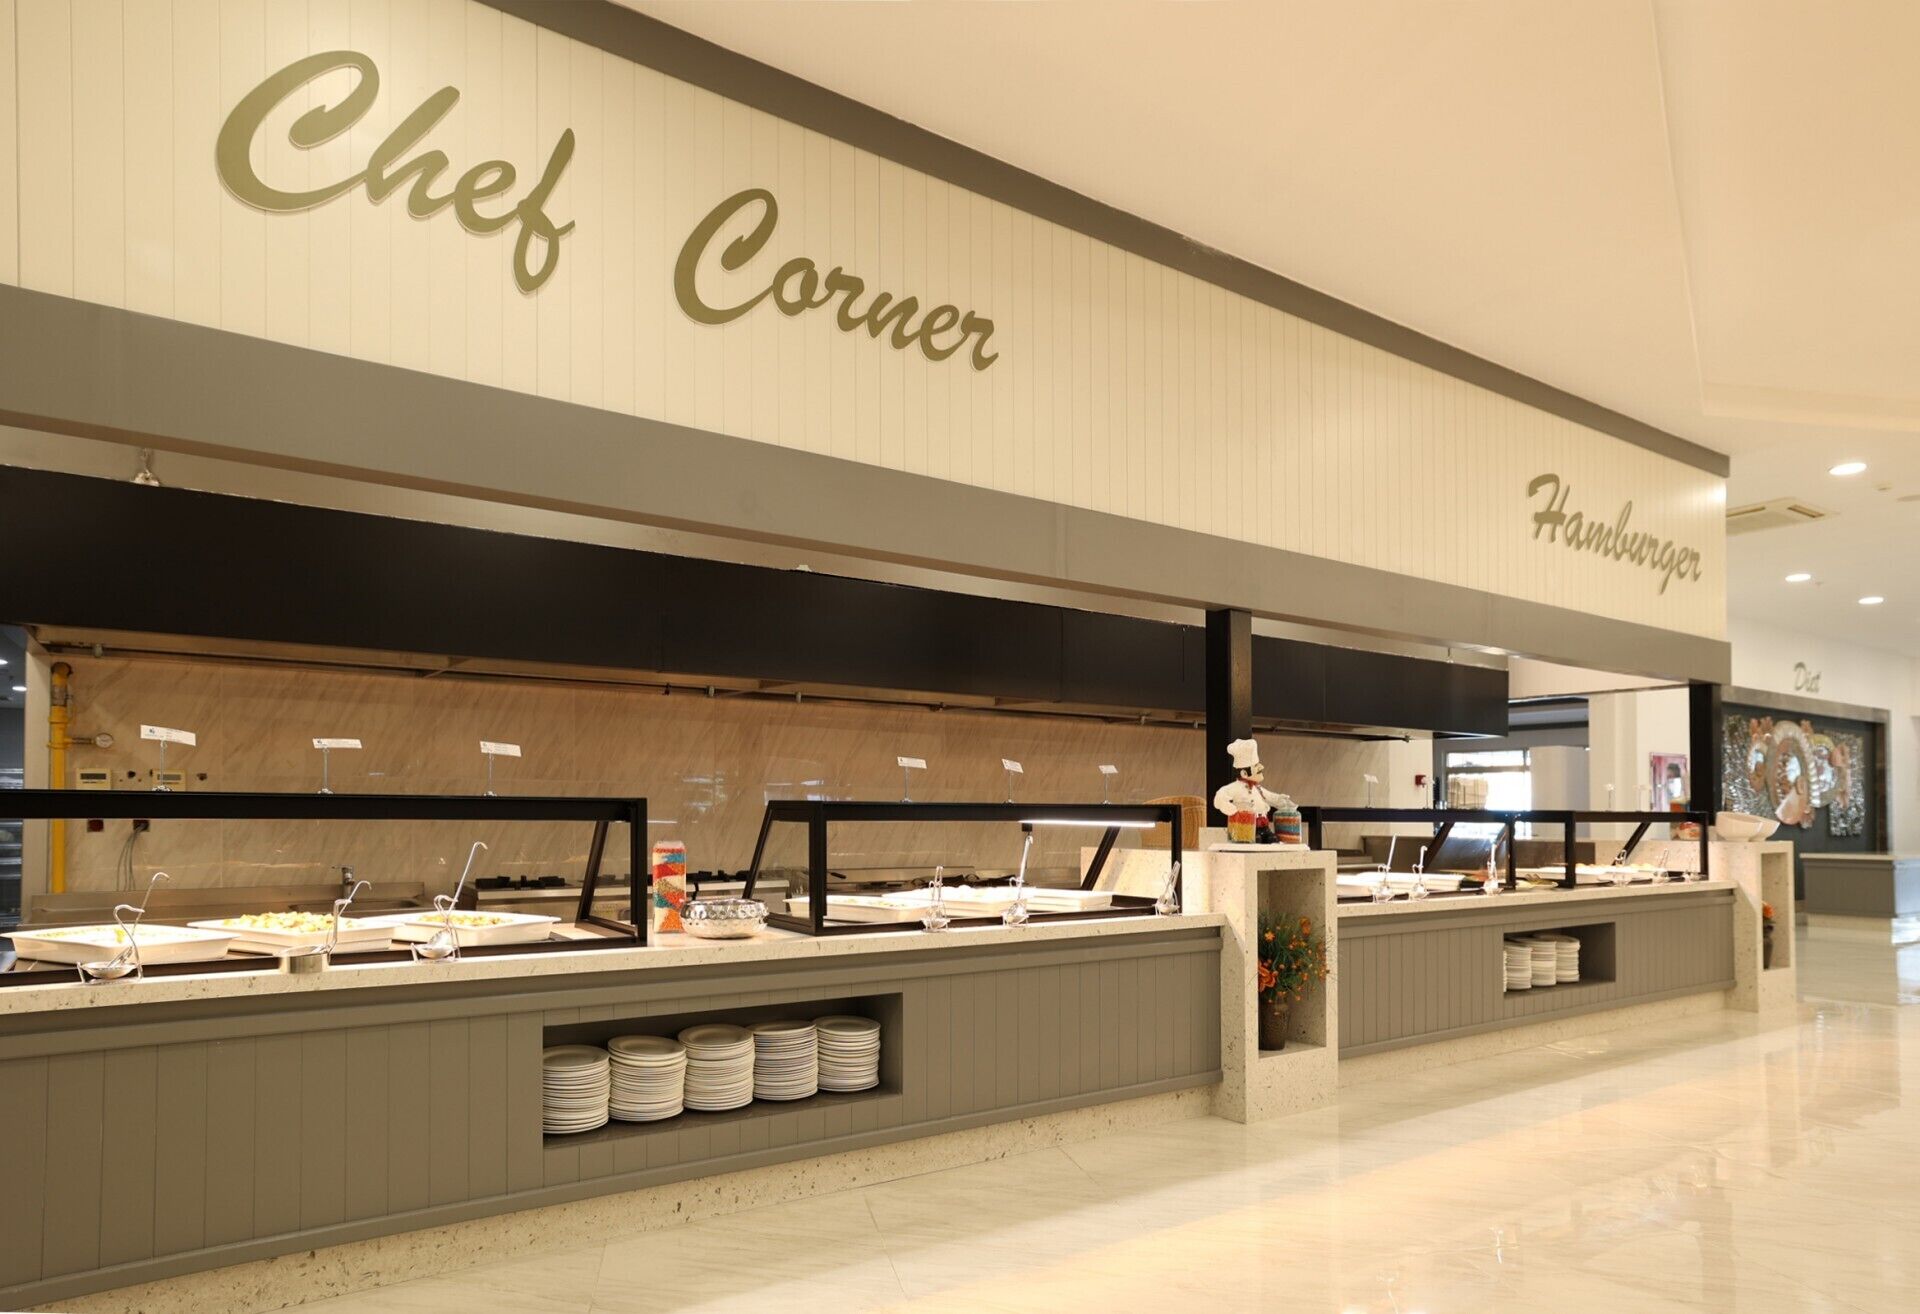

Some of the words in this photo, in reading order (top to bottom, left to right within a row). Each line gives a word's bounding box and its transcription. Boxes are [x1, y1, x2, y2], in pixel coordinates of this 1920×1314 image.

[216, 50, 576, 294] Chef
[673, 188, 1000, 371] Corner
[1527, 473, 1702, 595] Hamburger
[1794, 661, 1821, 693] Diet
